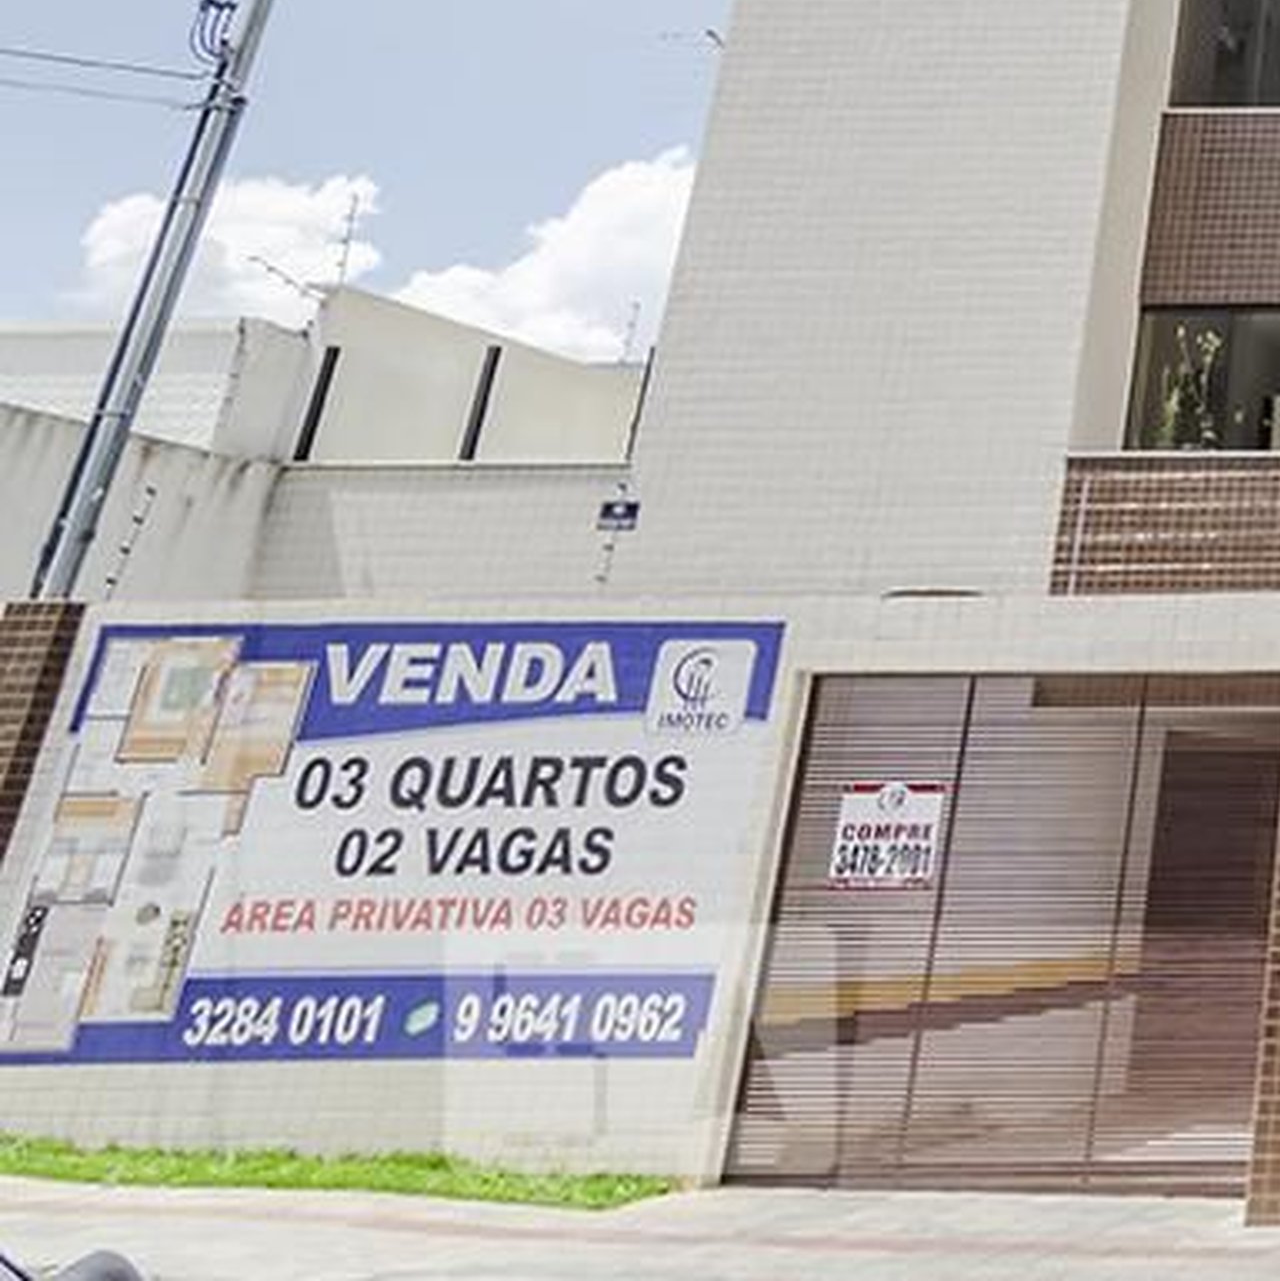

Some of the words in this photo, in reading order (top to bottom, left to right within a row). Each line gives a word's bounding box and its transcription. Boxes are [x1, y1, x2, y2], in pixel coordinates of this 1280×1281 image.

[326, 641, 618, 704] VENDA
[657, 712, 731, 731] IMOTEC
[295, 756, 369, 810] 03
[389, 755, 688, 811] QUARTOS
[335, 827, 405, 877] 02
[425, 827, 615, 876] VAGAS
[842, 823, 933, 841] COMPRE
[328, 897, 513, 933] PRIVATIVA
[526, 897, 566, 931] 03
[581, 896, 698, 931] VAGAS
[182, 994, 280, 1046] 3284
[287, 994, 386, 1046] 0101
[452, 994, 481, 1044] 9
[487, 993, 580, 1044] 9641
[590, 991, 686, 1043] 0962
